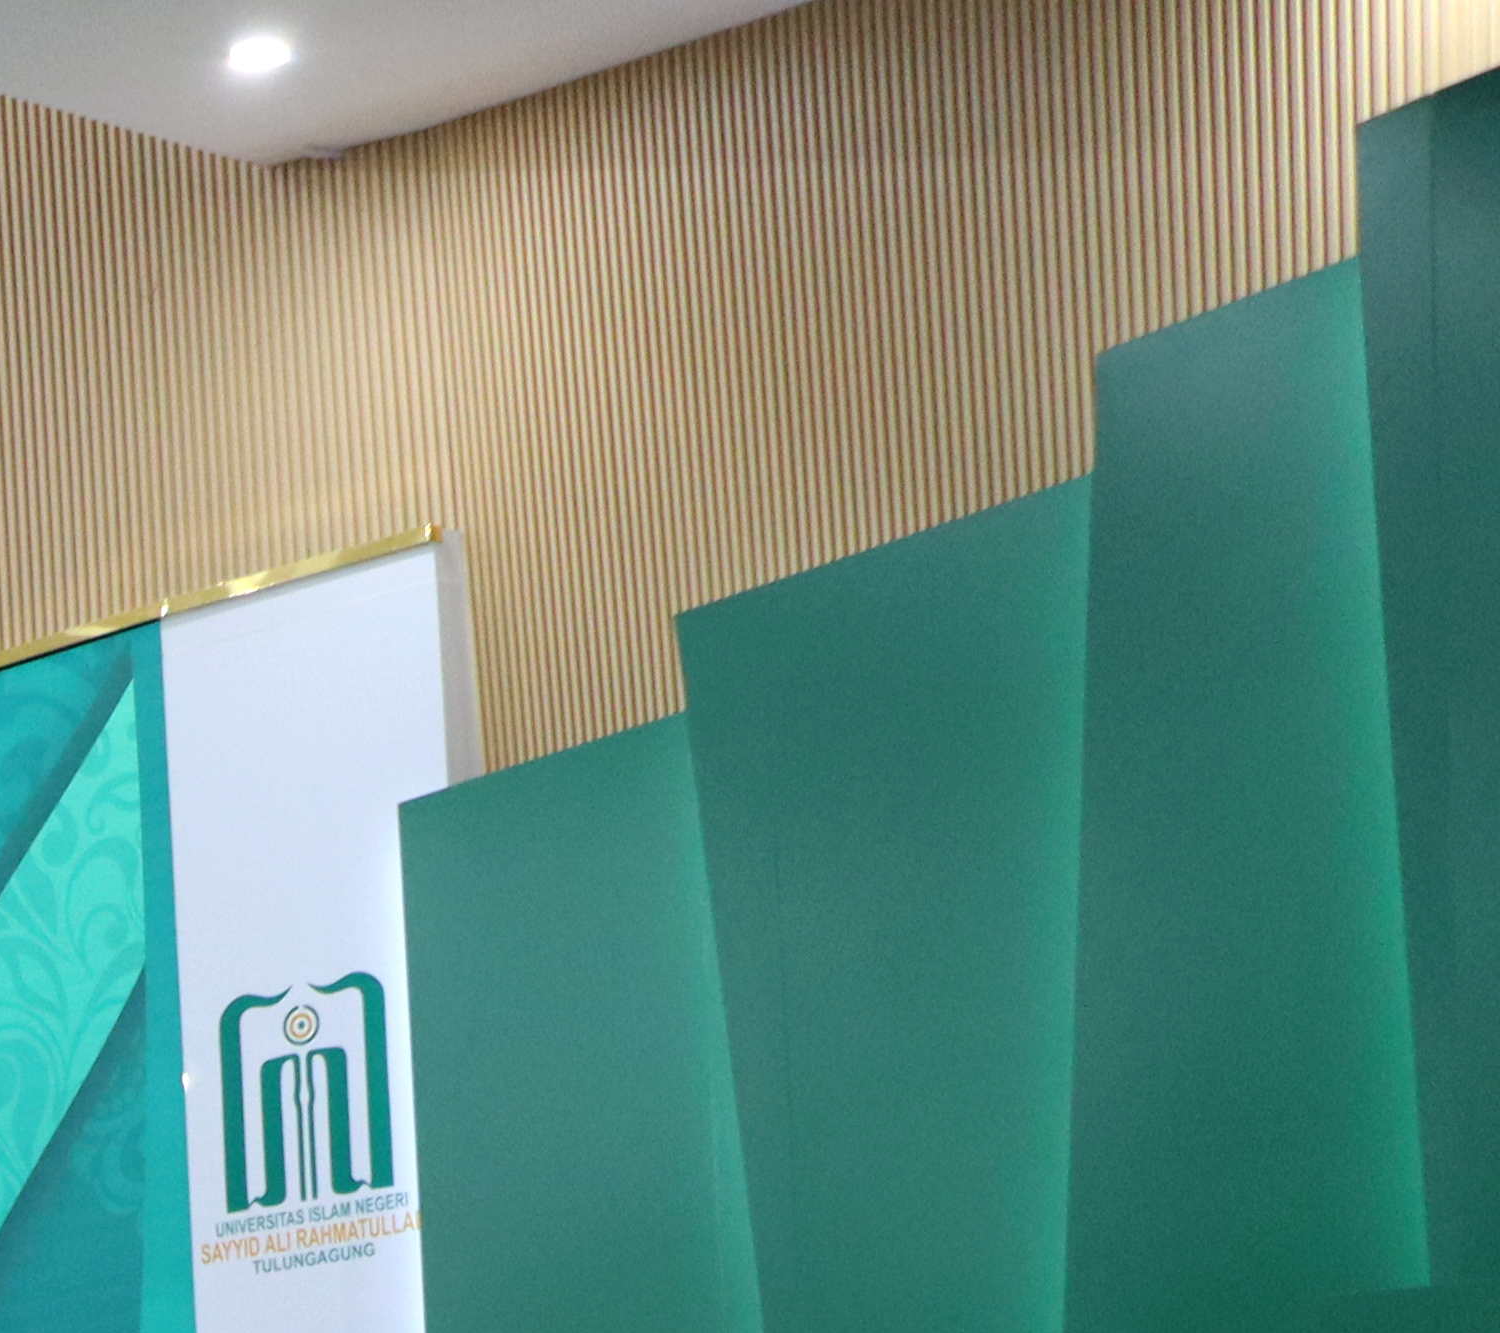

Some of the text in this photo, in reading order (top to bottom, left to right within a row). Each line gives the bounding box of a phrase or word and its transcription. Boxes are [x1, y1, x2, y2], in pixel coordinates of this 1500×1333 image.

[215, 1192, 409, 1238] UNIVERSITAS ISLAM NEGERI
[201, 1236, 261, 1265] SAYYID
[266, 1231, 292, 1254] ALI
[252, 1242, 376, 1275] TULUNGAGUNG
